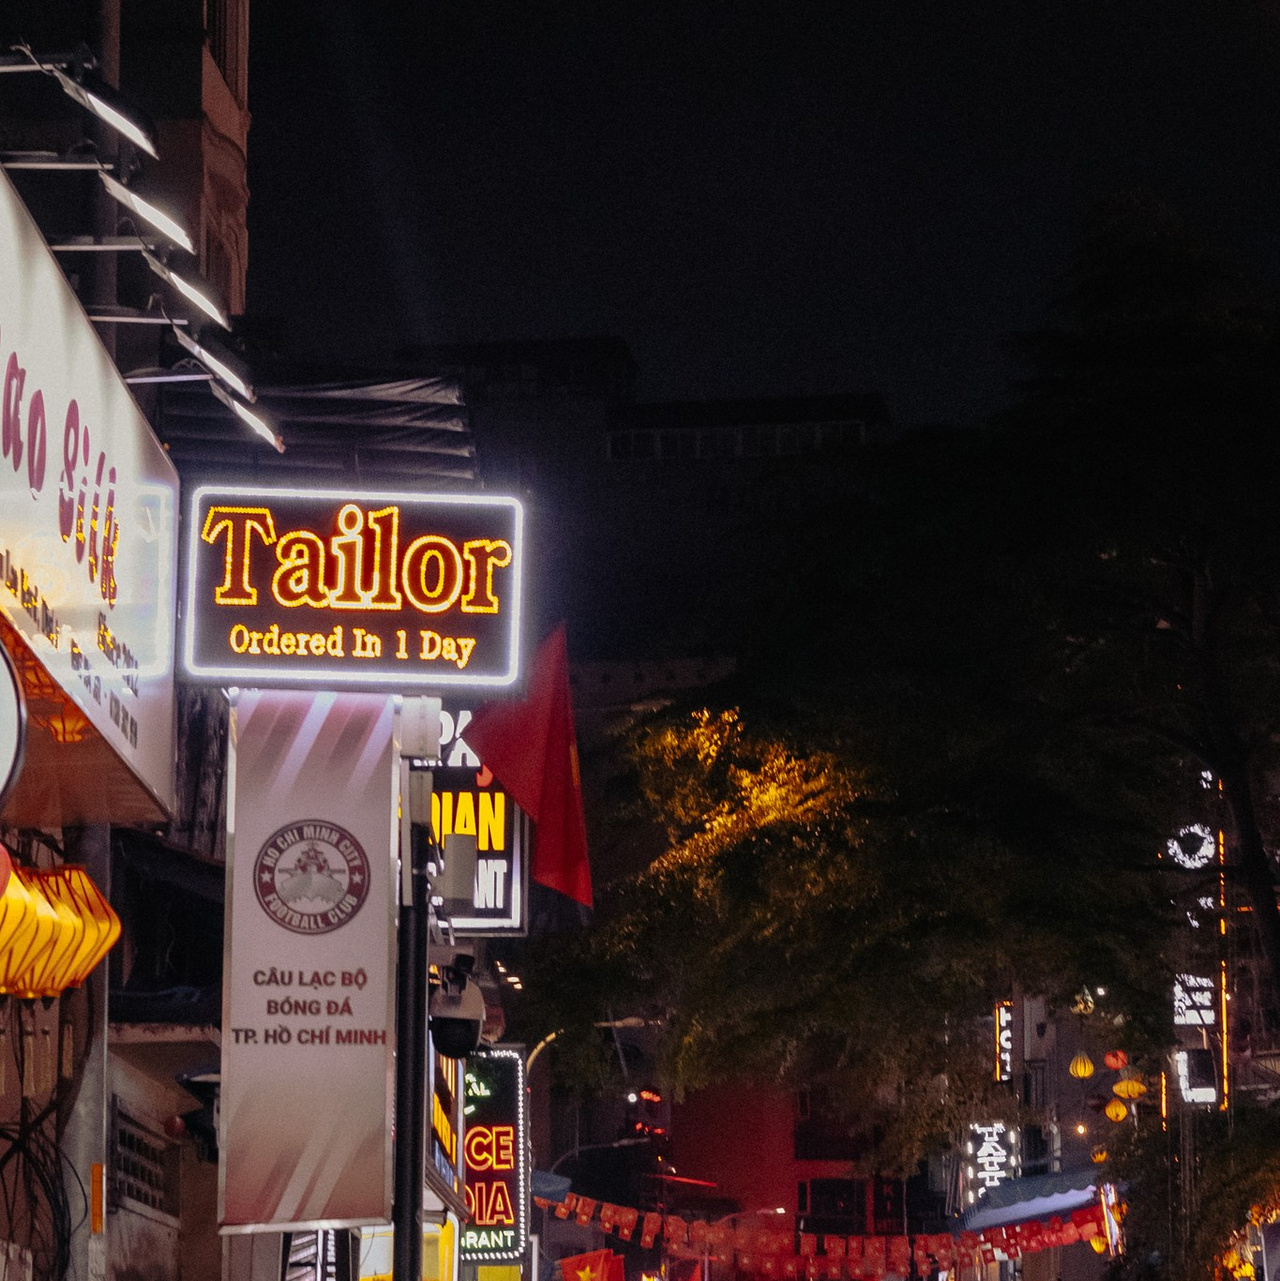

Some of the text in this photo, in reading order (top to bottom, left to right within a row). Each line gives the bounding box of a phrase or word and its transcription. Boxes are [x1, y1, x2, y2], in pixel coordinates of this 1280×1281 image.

[200, 503, 513, 614] Tailor
[229, 623, 477, 670] Ordered In 1 Day
[262, 846, 280, 868] HO
[276, 827, 301, 851] CHI
[303, 824, 341, 846] MINH
[326, 893, 359, 925] CLUB
[252, 966, 368, 991] CÂU LẠC BỘ
[266, 995, 353, 1016] BÓNG ĐÁ
[231, 1023, 387, 1045] TP. HỒ CHÍ MINH
